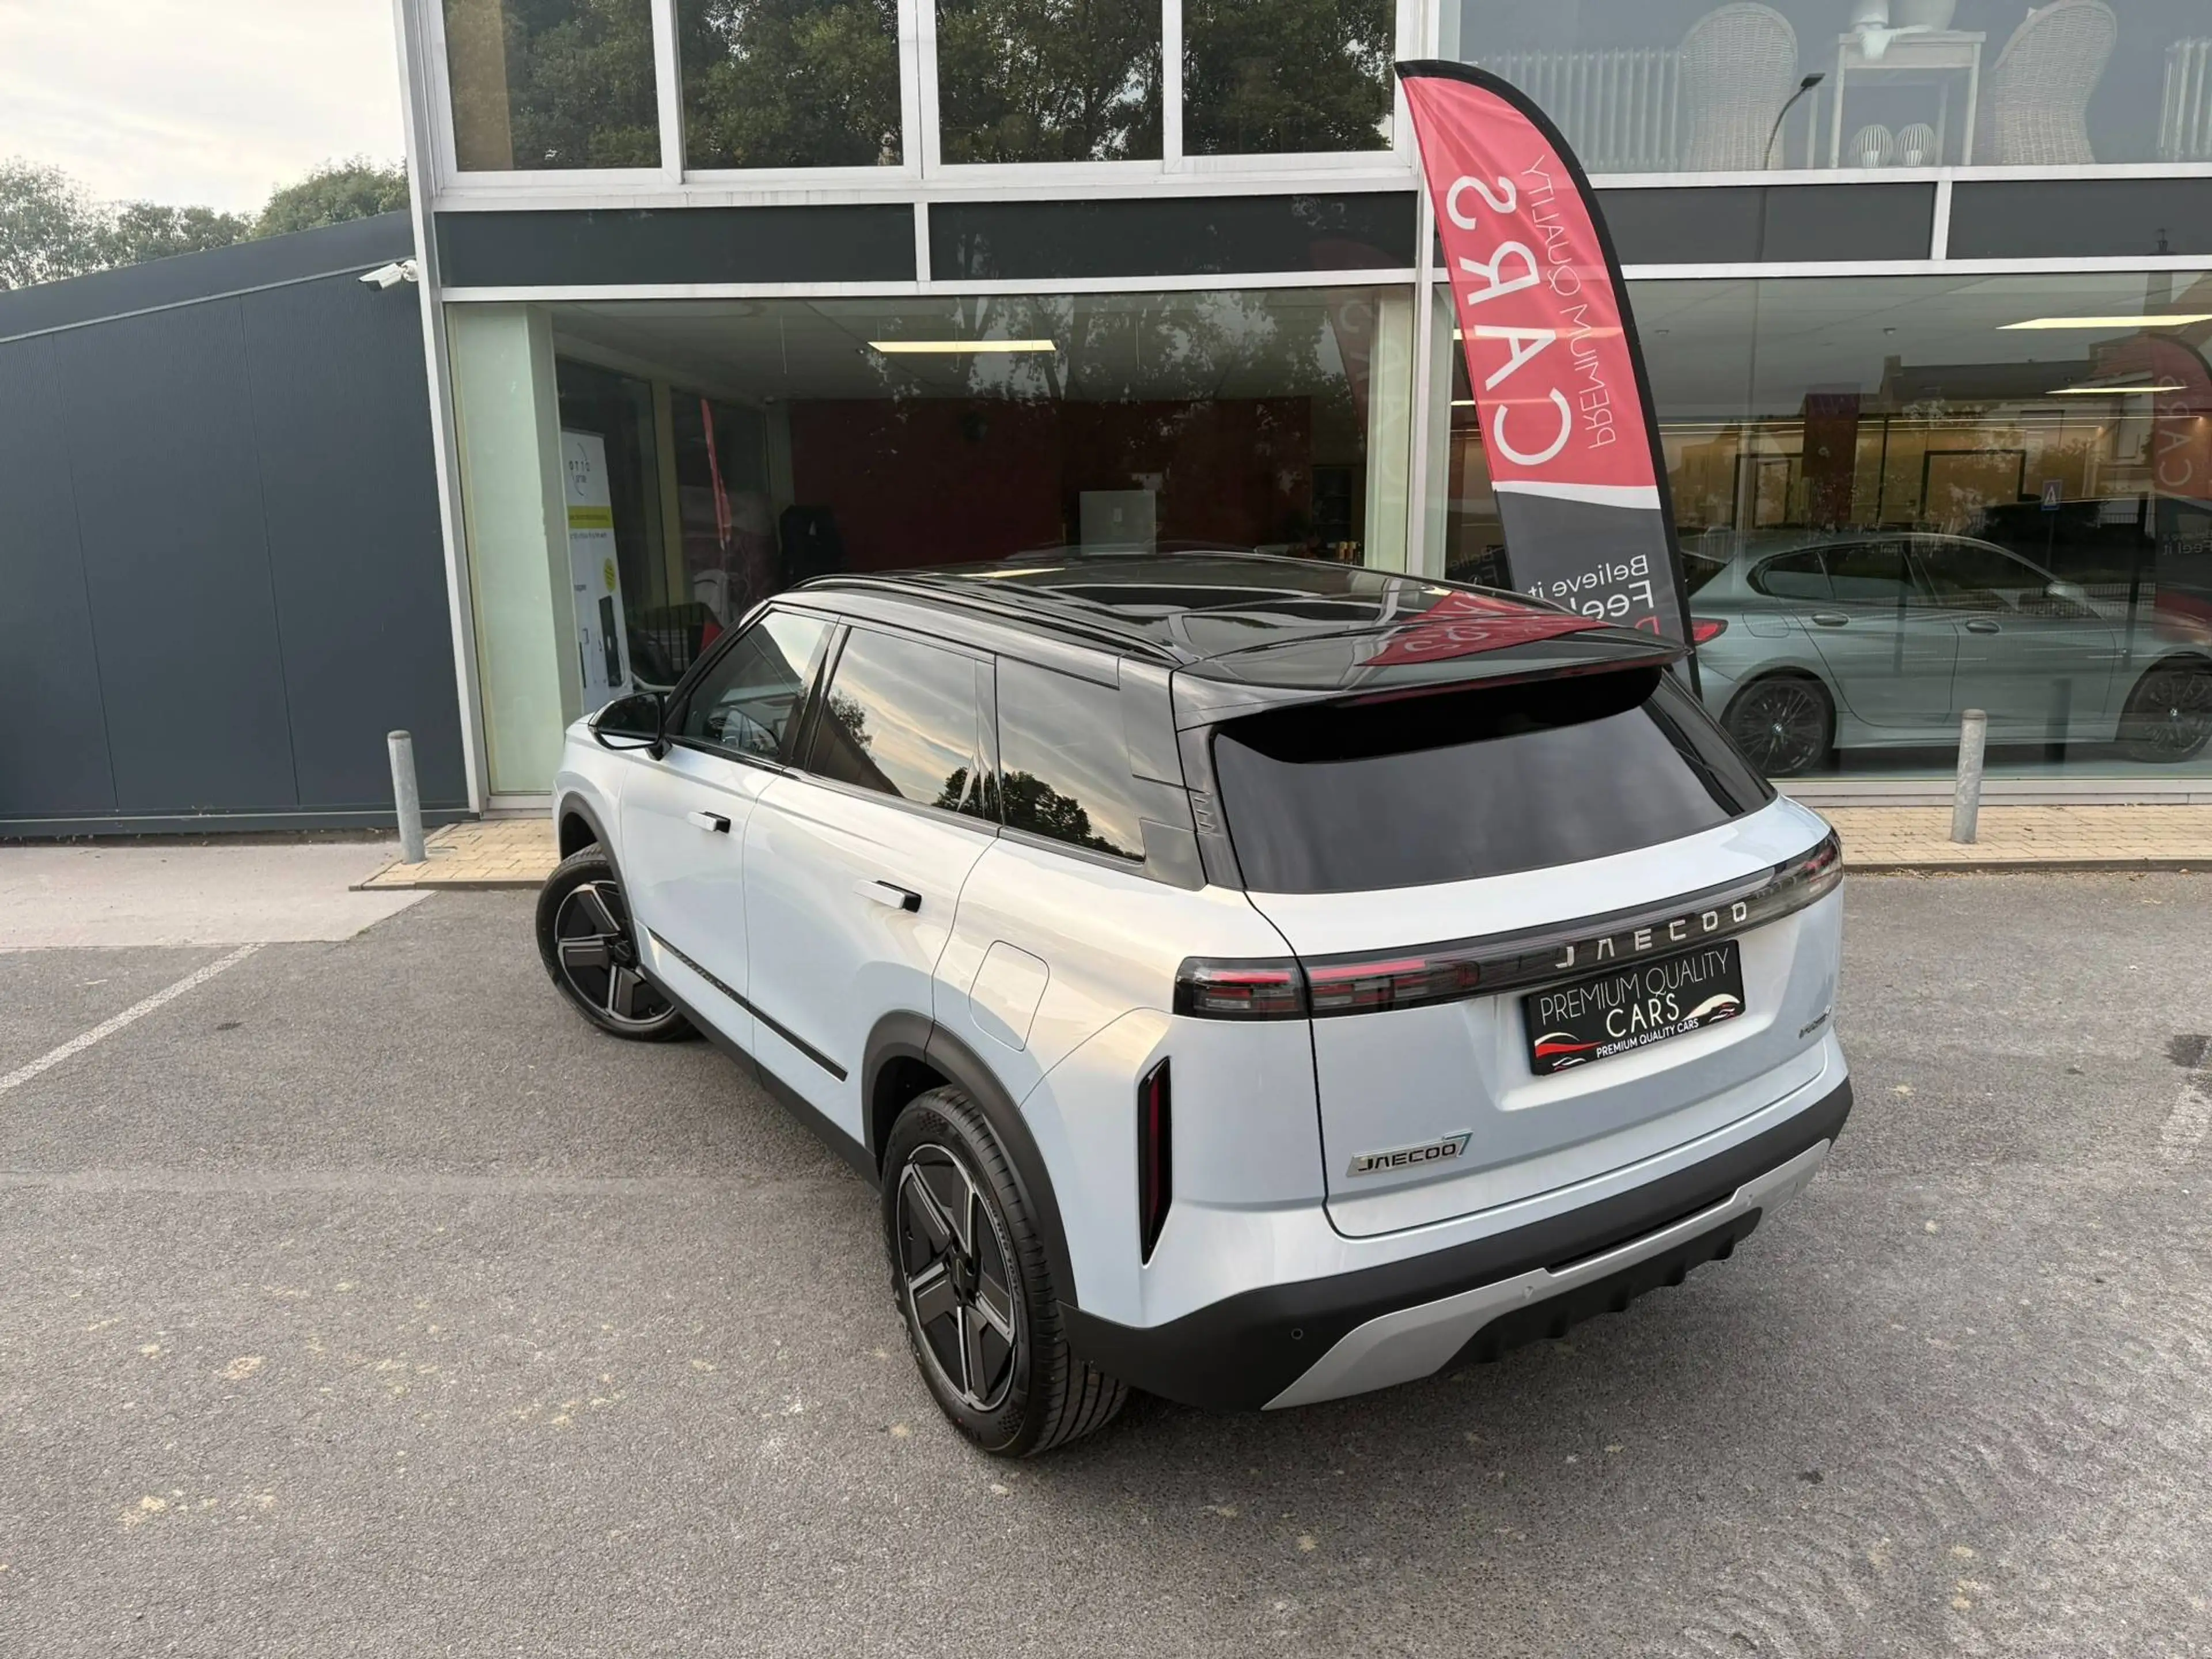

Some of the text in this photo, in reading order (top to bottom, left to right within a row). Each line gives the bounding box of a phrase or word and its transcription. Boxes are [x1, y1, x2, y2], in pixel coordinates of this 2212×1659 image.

[1555, 902, 1747, 969] JAECOO
[1540, 948, 1729, 1026] PREMIUM QUALITY
[1605, 993, 1680, 1038] CARS
[1596, 1018, 1699, 1059] PREMIUM QUALITY CARS
[1357, 1143, 1457, 1172] JAECOO
